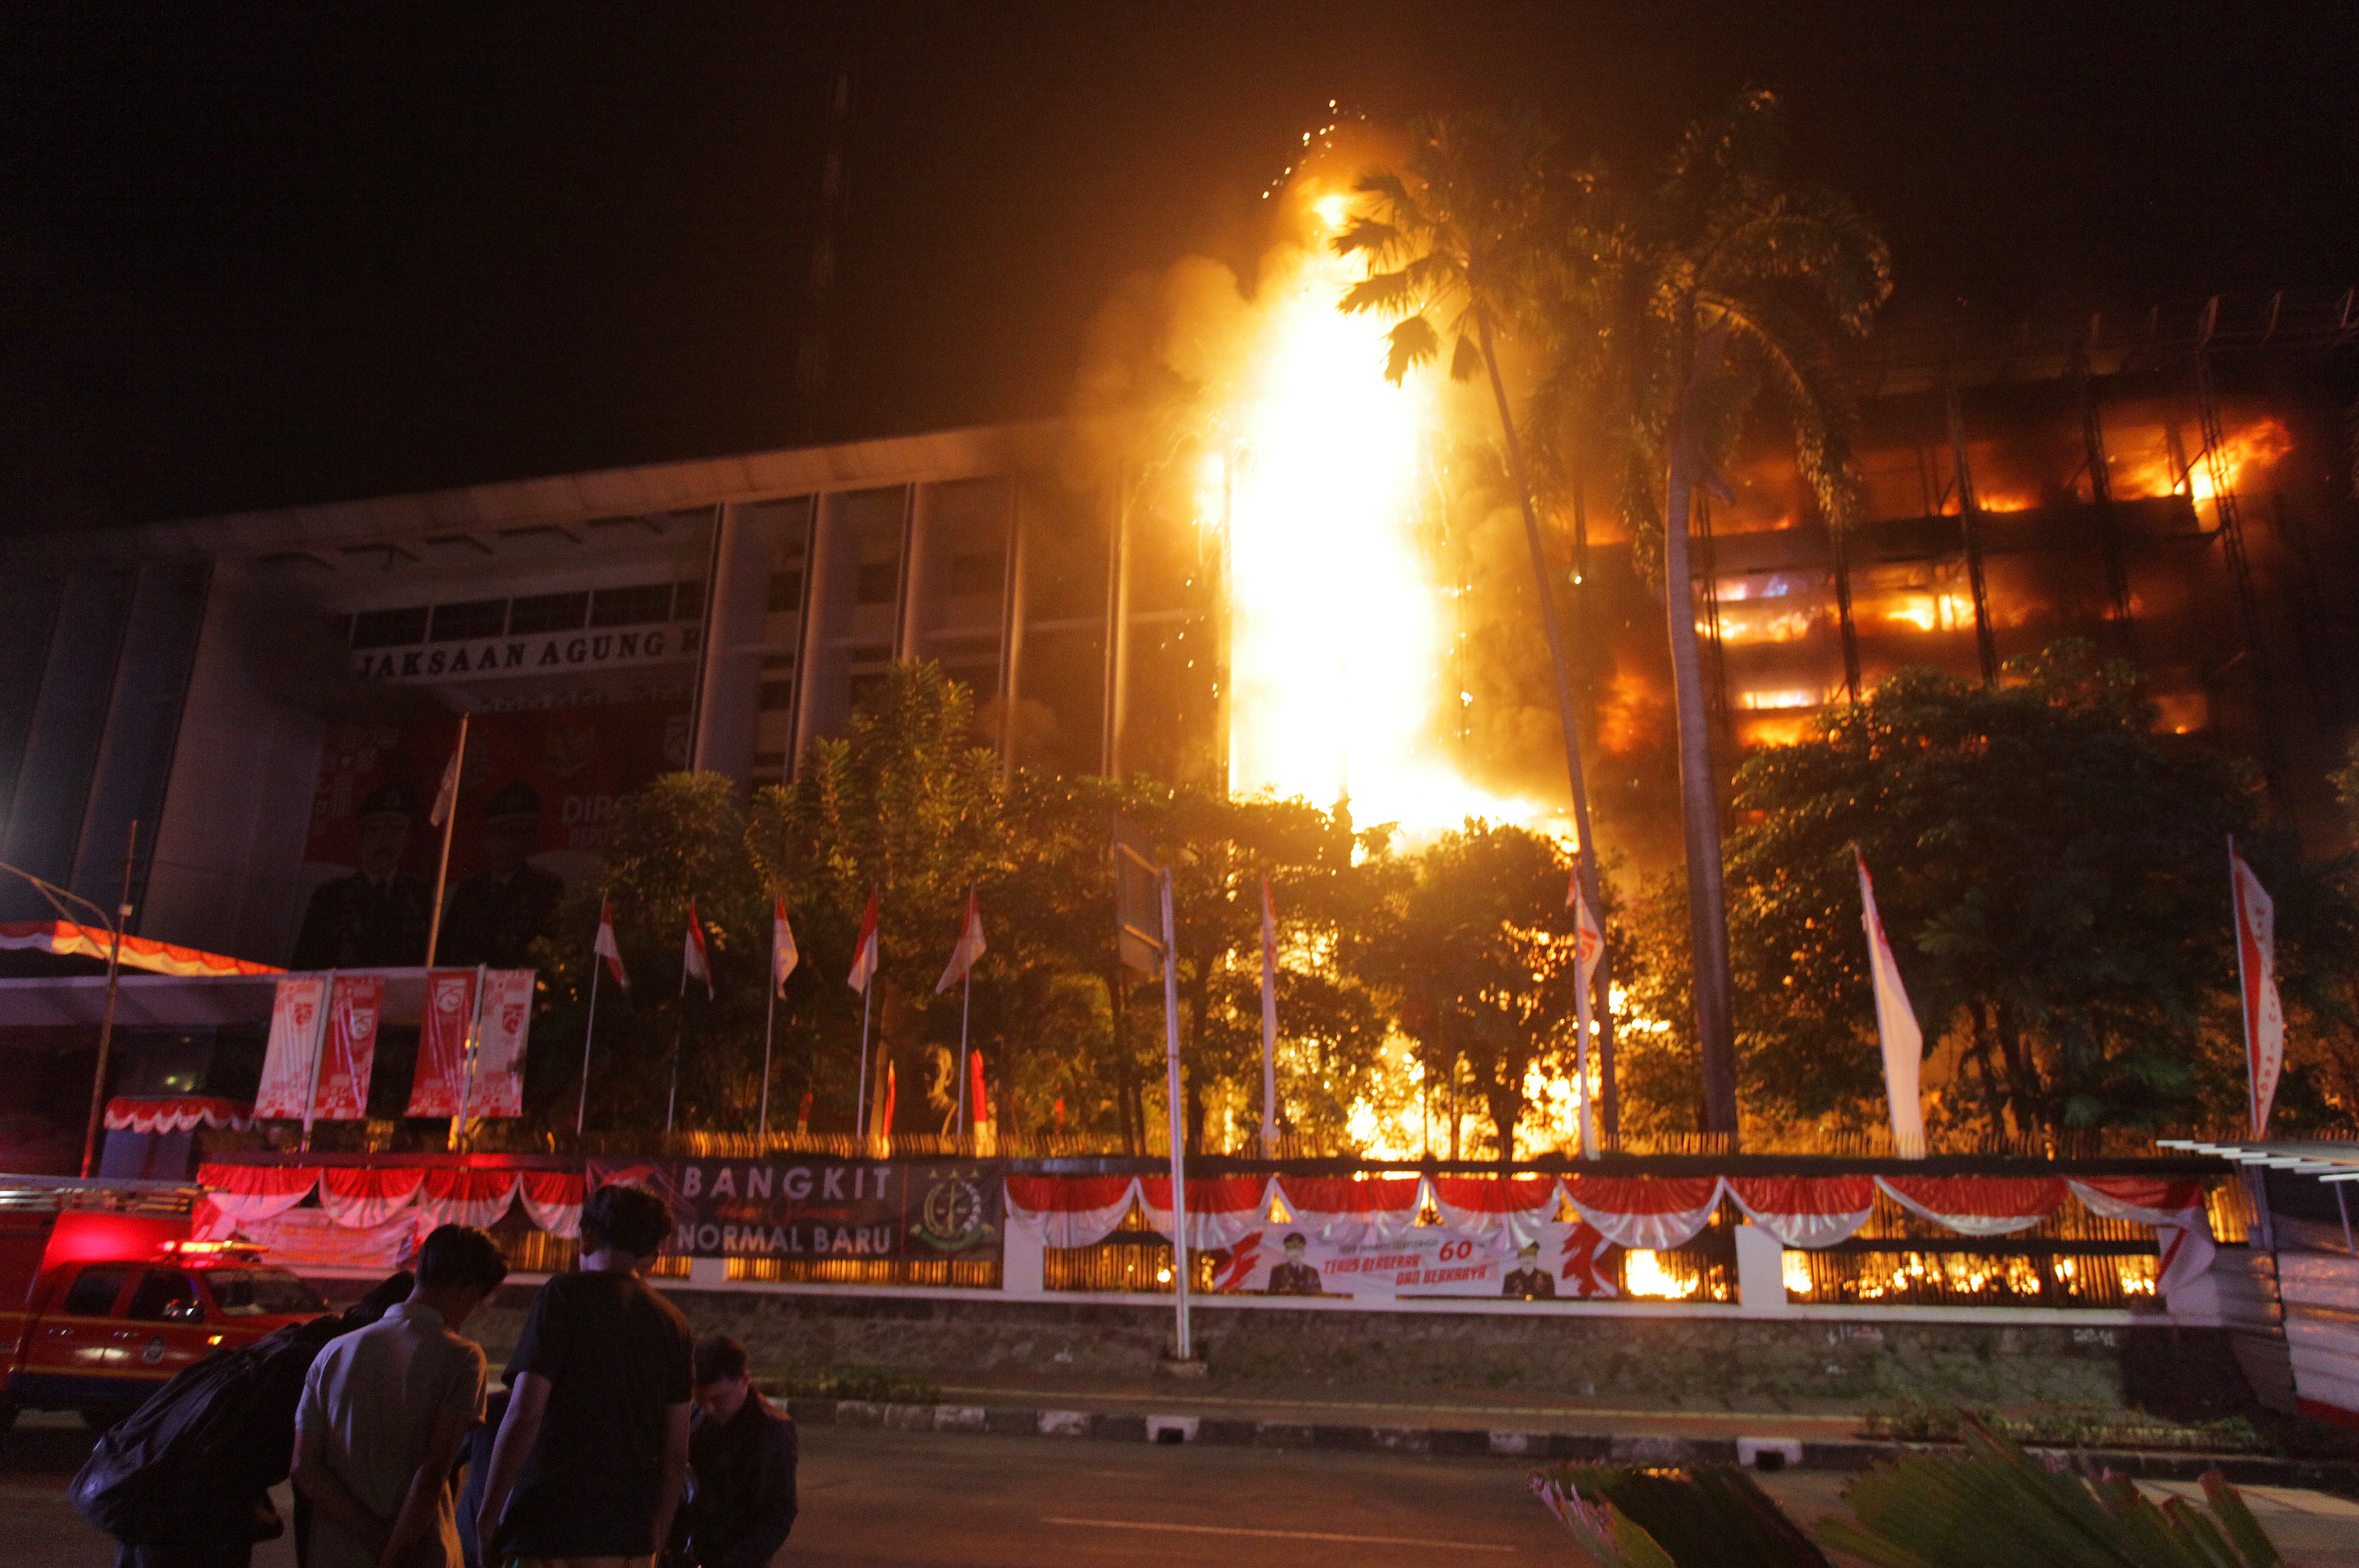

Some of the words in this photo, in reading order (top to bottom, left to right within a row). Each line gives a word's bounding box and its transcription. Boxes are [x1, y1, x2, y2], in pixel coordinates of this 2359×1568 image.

[356, 642, 526, 680] JAKSAAN
[538, 630, 667, 666] AGUNG
[681, 1165, 892, 1200] BANGKIT
[677, 1223, 804, 1253] NORMAL
[813, 1225, 891, 1255] BARU
[1439, 1240, 1473, 1261] 60
